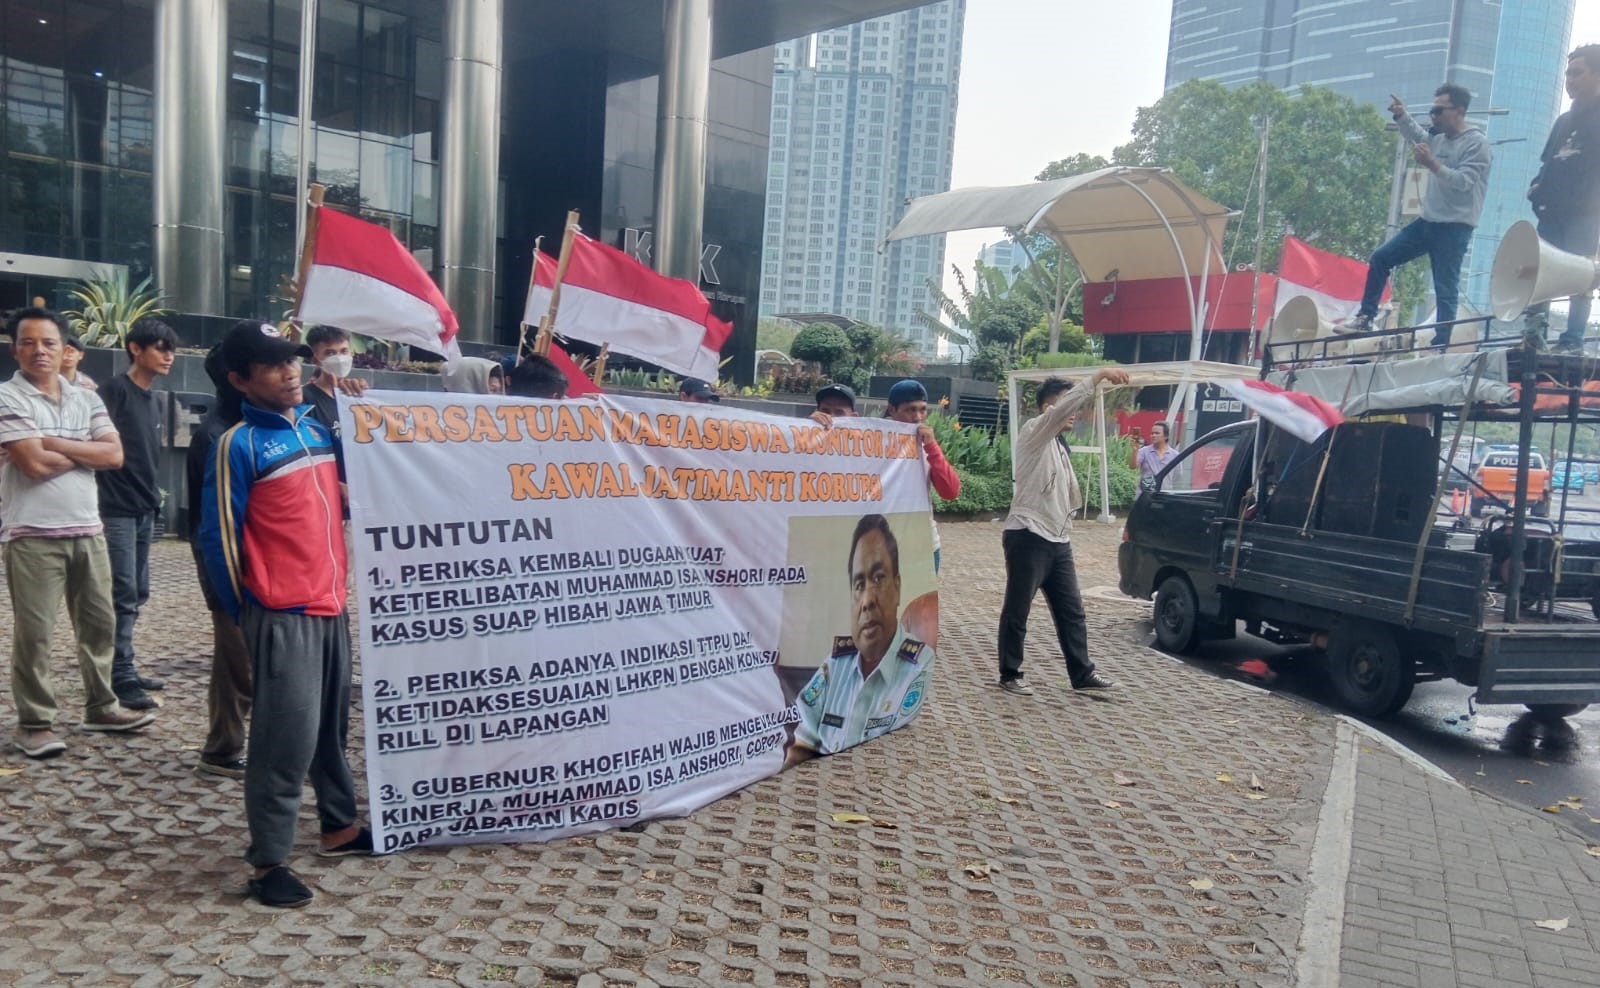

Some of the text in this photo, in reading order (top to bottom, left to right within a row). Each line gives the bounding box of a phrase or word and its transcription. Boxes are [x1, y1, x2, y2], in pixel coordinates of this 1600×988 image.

[351, 405, 606, 443] PERSATUAN
[609, 411, 789, 453] MAHASISWA
[790, 425, 883, 459] MONITOR
[508, 462, 638, 500] KAWAL
[1493, 457, 1534, 466] POLIE
[365, 517, 553, 552] TUNTUTAN
[368, 546, 724, 587] 1. PERIKSA KEMBALI DUGAAN UAT
[370, 567, 805, 615] KETERLIBATAN MUHAMMAD ISA NSHORI PADA
[372, 590, 711, 642] KASUS SUAP HIBAH JAWA TIMUR
[374, 680, 397, 698] 2.
[408, 665, 521, 694] PERIKSA
[529, 652, 615, 679] ADANYA
[621, 639, 693, 665] INDIKASI
[697, 633, 730, 652] TTPU
[376, 679, 609, 724] KETIDAKSESUAIAN
[617, 667, 674, 693] LHKPN
[680, 655, 734, 680] DENGAN
[378, 705, 607, 751] RILL DI LAPANGAN
[380, 785, 402, 801] 3.
[412, 766, 555, 797] GUBERNUR
[564, 741, 664, 779] KHOFIFAH
[669, 730, 715, 756] WAJIB
[381, 799, 497, 827] KINERJA
[503, 775, 641, 809] MUHAMMAD
[648, 766, 674, 789] ISA
[680, 746, 742, 778] ANSHORI,
[450, 809, 561, 832] JABATAN
[571, 800, 639, 824] KADIS
